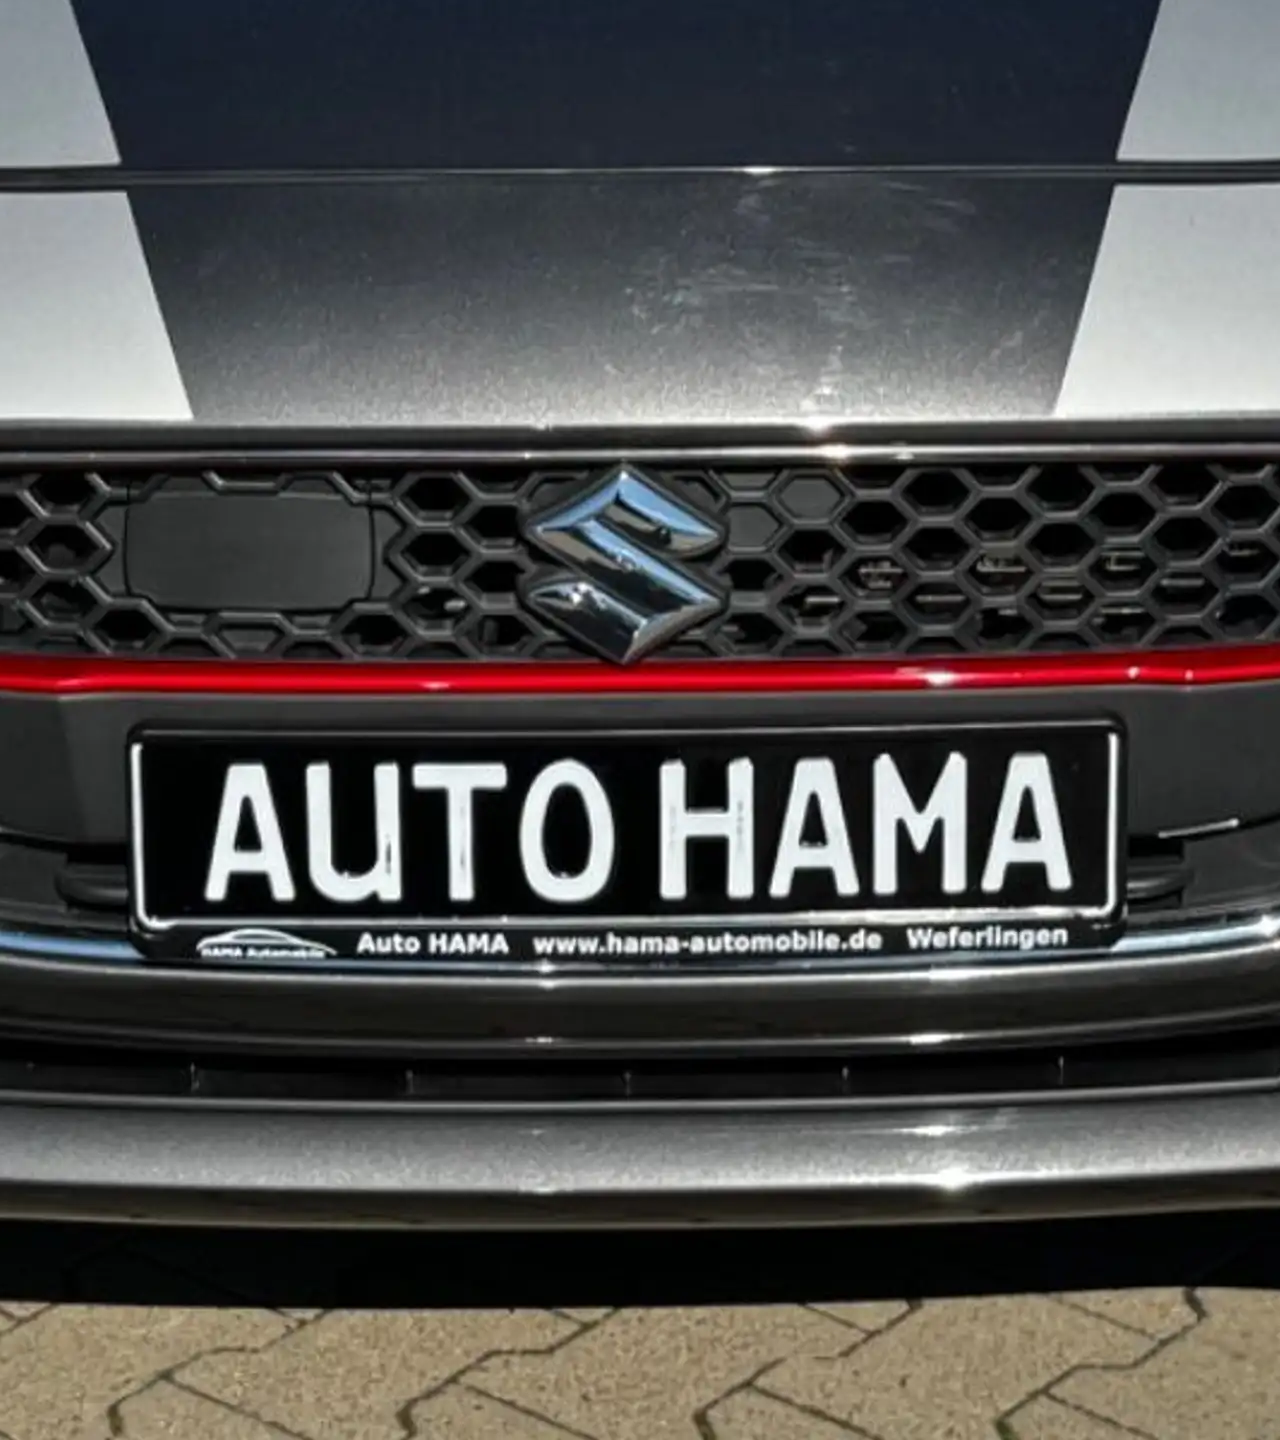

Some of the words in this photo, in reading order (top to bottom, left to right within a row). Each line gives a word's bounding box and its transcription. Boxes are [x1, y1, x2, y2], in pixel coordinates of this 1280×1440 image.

[203, 758, 616, 904] AUTO
[658, 751, 1073, 901] HAMA
[356, 931, 421, 955] Auto
[429, 931, 511, 955] HAMA
[532, 929, 884, 956] www.hama-automobile.de
[905, 924, 1070, 951] Weferlingen
